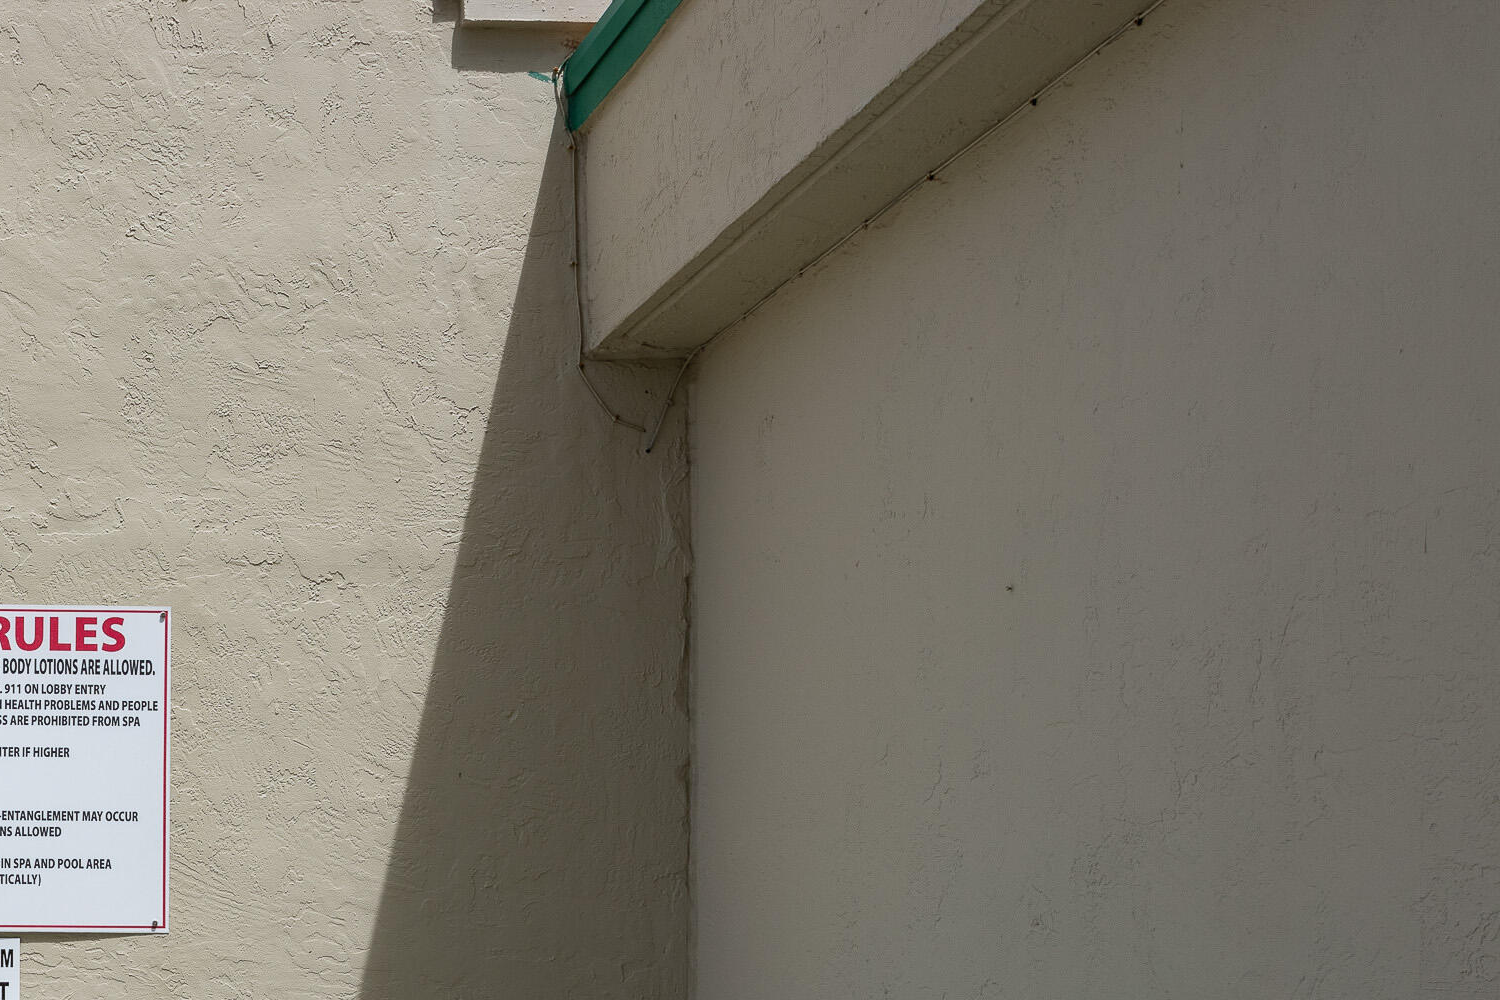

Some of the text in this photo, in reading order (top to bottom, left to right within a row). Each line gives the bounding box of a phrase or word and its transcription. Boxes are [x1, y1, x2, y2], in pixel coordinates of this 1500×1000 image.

[2, 658, 32, 675] BODY
[34, 658, 78, 675] LOTIONS
[80, 659, 101, 676] ARE
[102, 659, 155, 676] ALLOWED.
[4, 683, 21, 694] 911
[24, 684, 39, 695] ON
[41, 684, 73, 695] LOBBY
[74, 684, 106, 695] ENTRY
[4, 699, 42, 710] HEALTH
[43, 700, 96, 711] PROBLEMS
[97, 700, 120, 711] AND
[121, 700, 158, 711] PEOPLE
[9, 715, 29, 726] ARE
[30, 716, 90, 727] PROHIBITED
[91, 716, 120, 727] FROM
[122, 716, 140, 727] SPA
[22, 747, 31, 758] IF
[32, 747, 70, 758] HIGHER
[81, 811, 103, 822] MAY
[105, 811, 138, 822] OCCUR
[14, 826, 61, 837] ALLOWED
[0, 858, 11, 869] IN
[13, 858, 31, 869] SPA
[33, 858, 55, 869] AND
[57, 858, 84, 869] POOL
[85, 859, 112, 870] AREA
